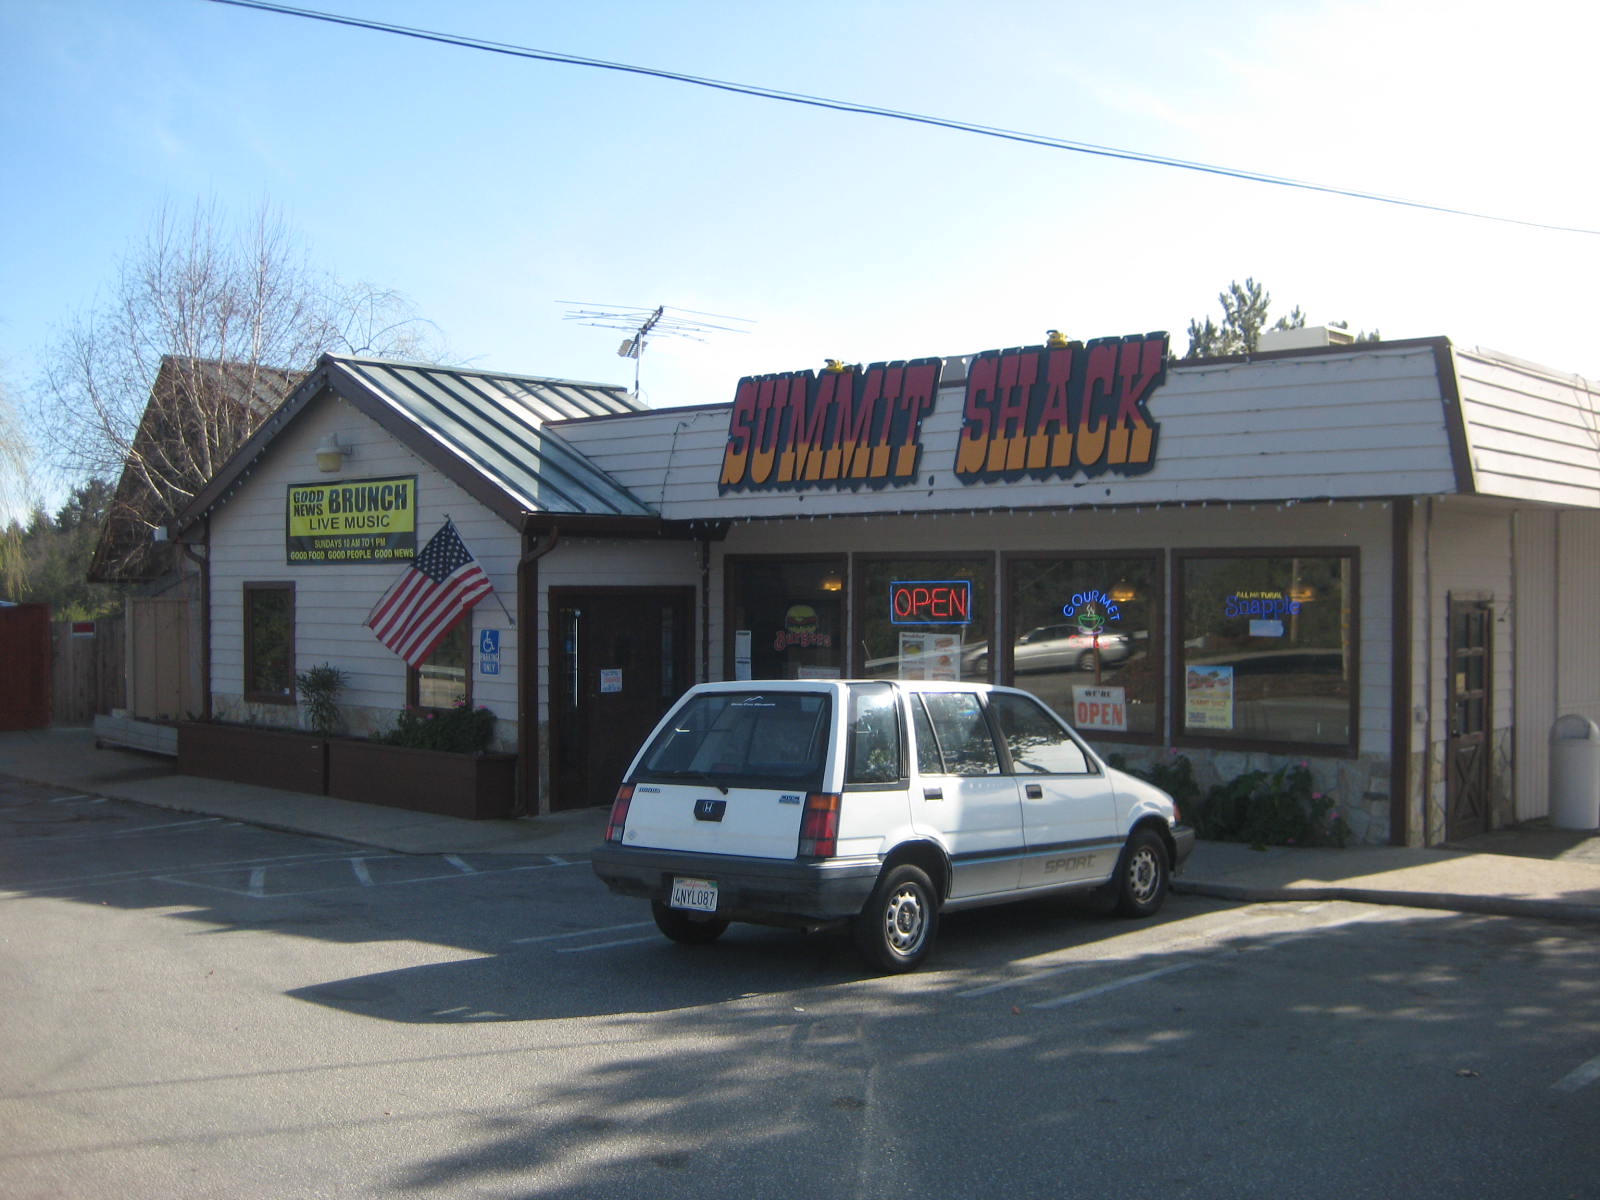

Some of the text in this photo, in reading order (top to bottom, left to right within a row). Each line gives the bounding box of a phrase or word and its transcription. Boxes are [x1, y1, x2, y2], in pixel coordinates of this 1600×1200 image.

[719, 339, 1168, 485] SUMMIT SHACK
[293, 490, 325, 504] GOOD
[328, 484, 408, 514] BRUNCH
[293, 503, 324, 517] NEWS
[309, 514, 391, 531] LIVE MUSIC
[314, 539, 342, 549] SUNDAYS
[350, 538, 361, 548] AM
[362, 538, 370, 547] TO
[375, 537, 386, 547] PM
[290, 548, 414, 561] GOOD FOOD GOOD PEOPLE GOOD NEWS
[894, 587, 967, 617] OPEN
[1236, 591, 1250, 599] ALL
[1062, 590, 1121, 621] GOURMET
[1225, 595, 1302, 620] Snapple
[1077, 702, 1124, 726] OPEN
[1043, 854, 1097, 874] SPORT
[674, 887, 715, 907] 4NYL087
